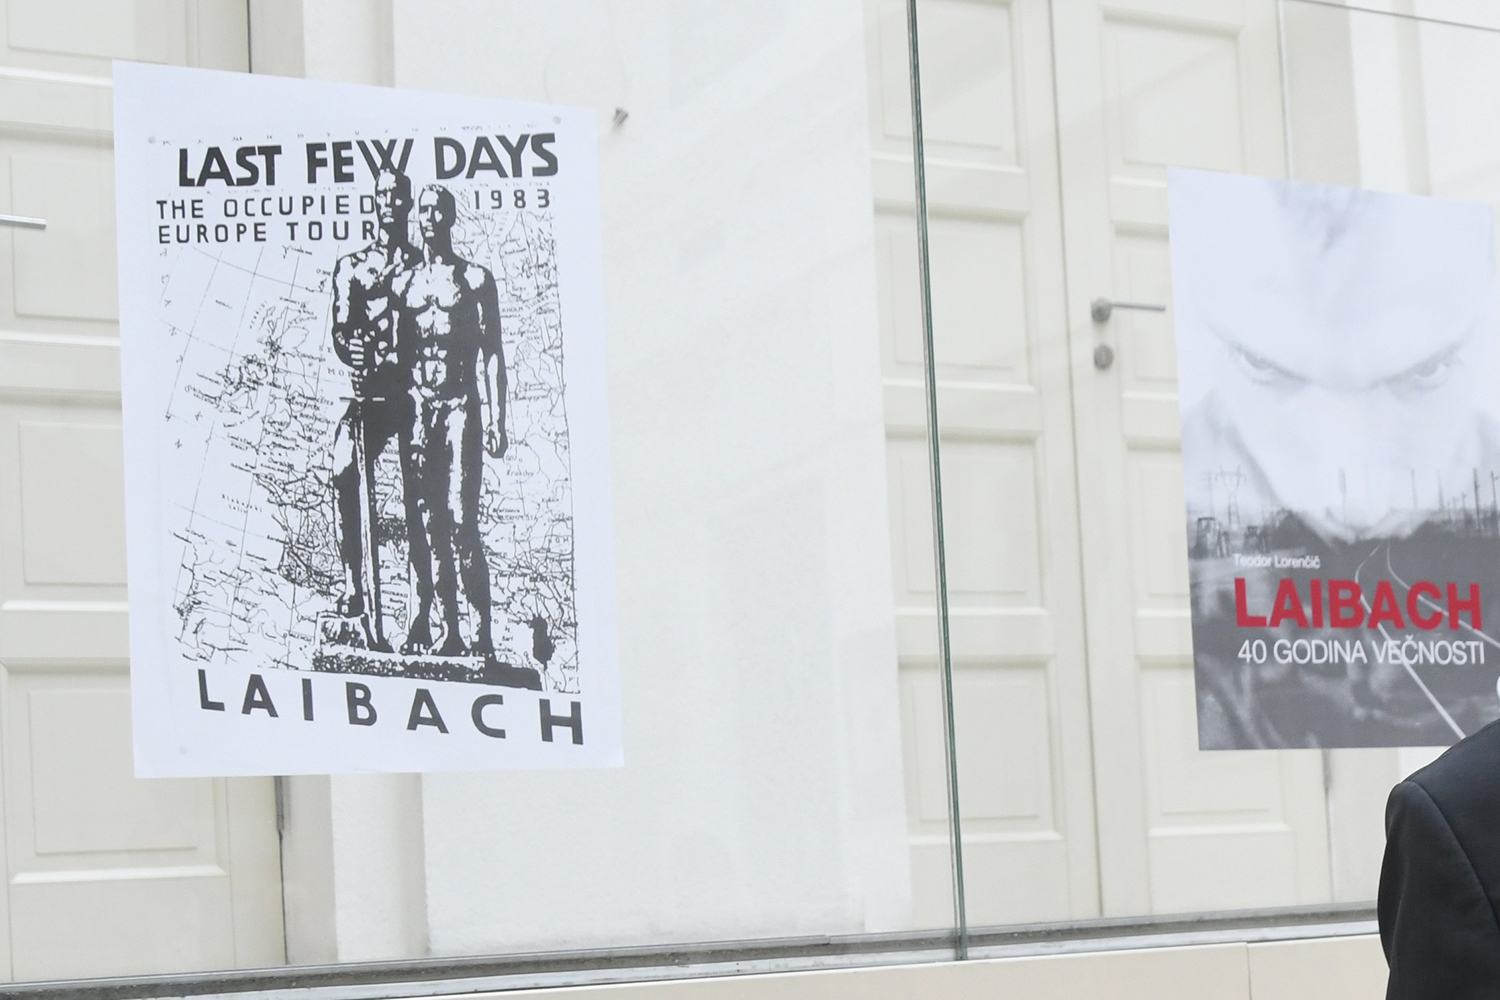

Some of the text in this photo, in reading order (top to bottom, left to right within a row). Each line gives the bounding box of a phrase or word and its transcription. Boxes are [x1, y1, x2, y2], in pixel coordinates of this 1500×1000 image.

[178, 132, 559, 187] LAST FEW DAYS
[156, 188, 550, 220] THE OCCUPIED 1983
[158, 220, 376, 244] EUROPE TOUR
[1233, 553, 1273, 568] Teodor
[1234, 577, 1483, 631] LAIBACH
[1237, 634, 1485, 666] 40 GODINA VEČNOSTI
[197, 668, 585, 746] LAIBACH
